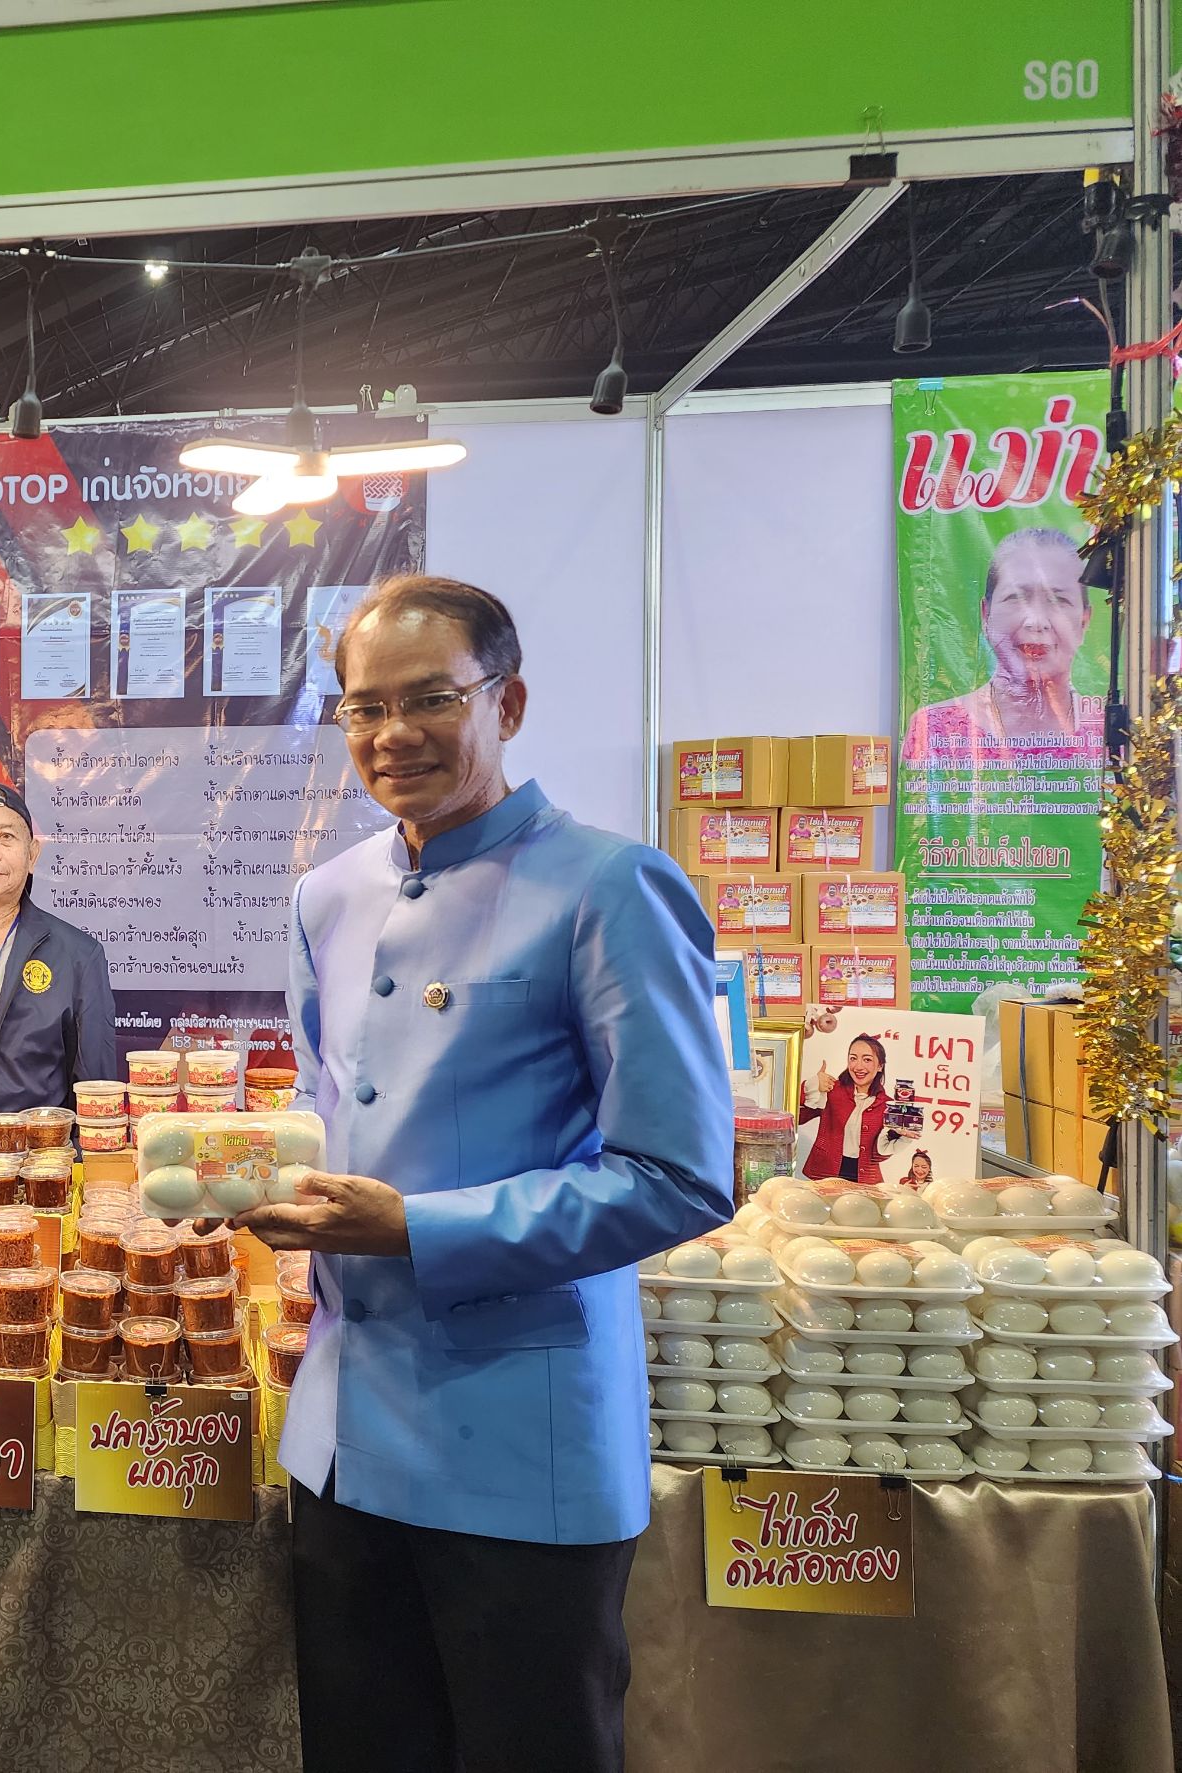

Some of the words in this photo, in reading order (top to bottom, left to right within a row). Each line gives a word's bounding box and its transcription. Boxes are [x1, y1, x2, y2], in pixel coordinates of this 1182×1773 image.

[1023, 59, 1099, 101] S60
[51, 747, 179, 768] น้ำพริกนรกปลาย่าง
[204, 745, 324, 766] น้ำพริกนรกแมงดา
[51, 786, 142, 807] น้ำพริกเผาเห็ด
[51, 823, 156, 844] น้ำพริกเผาไข่เค็ม
[918, 835, 1071, 868] วิธีทำไข่เค็มไชยา
[106, 955, 245, 974] ลาร้าบองก้อนอบแห้ง
[914, 1034, 974, 1063] เผา
[924, 1063, 971, 1091] เห็ด
[90, 1398, 241, 1451] ปลาร้าบอง
[127, 1439, 220, 1510] ผัดสุก
[736, 1487, 859, 1549] ไข่เค็ม
[725, 1538, 900, 1588] ดินสอพอง
